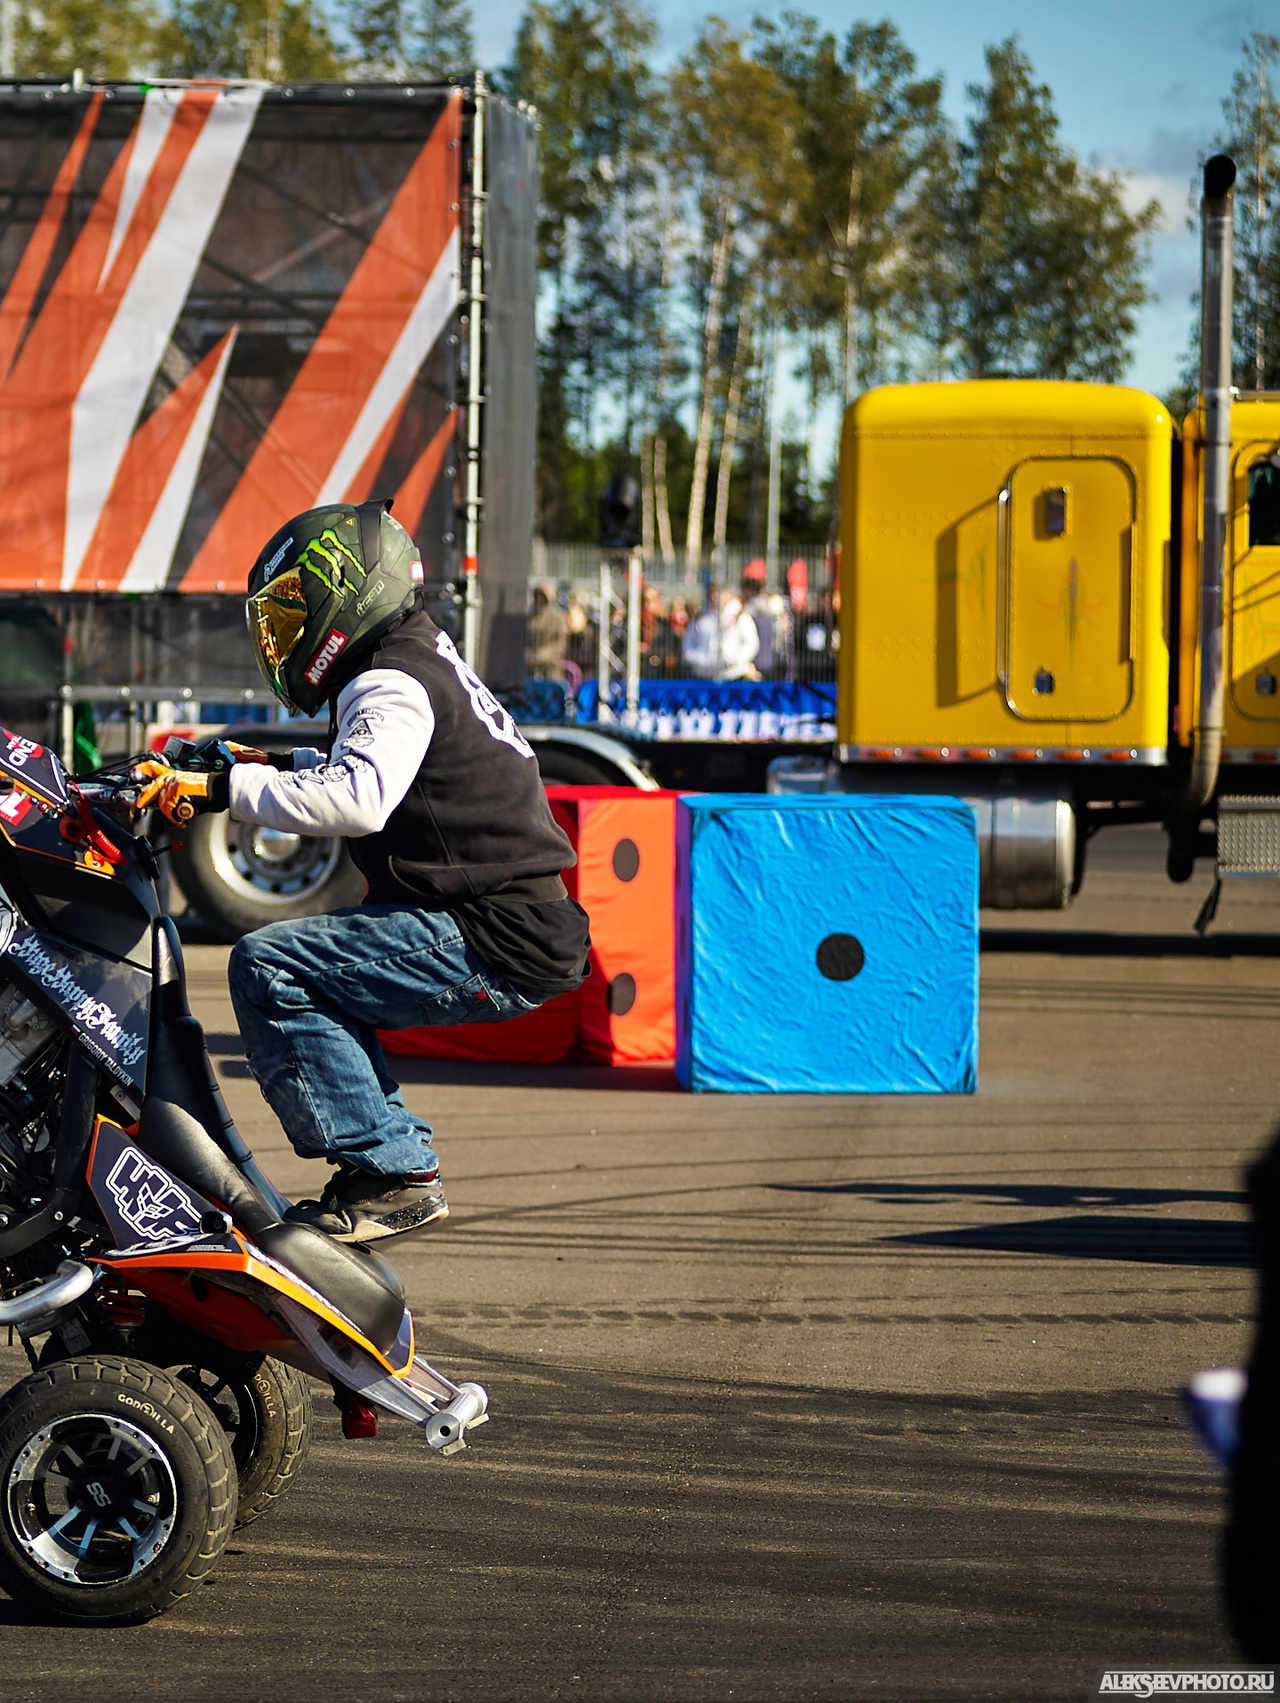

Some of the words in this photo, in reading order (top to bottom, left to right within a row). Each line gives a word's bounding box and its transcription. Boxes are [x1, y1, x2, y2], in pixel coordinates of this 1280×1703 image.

[306, 635, 345, 683] MOTUL
[8, 738, 38, 766] END
[78, 1033, 108, 1062] GRIGORIY
[104, 1057, 134, 1087] TALDYKIN
[117, 1393, 175, 1435] GODZILLA
